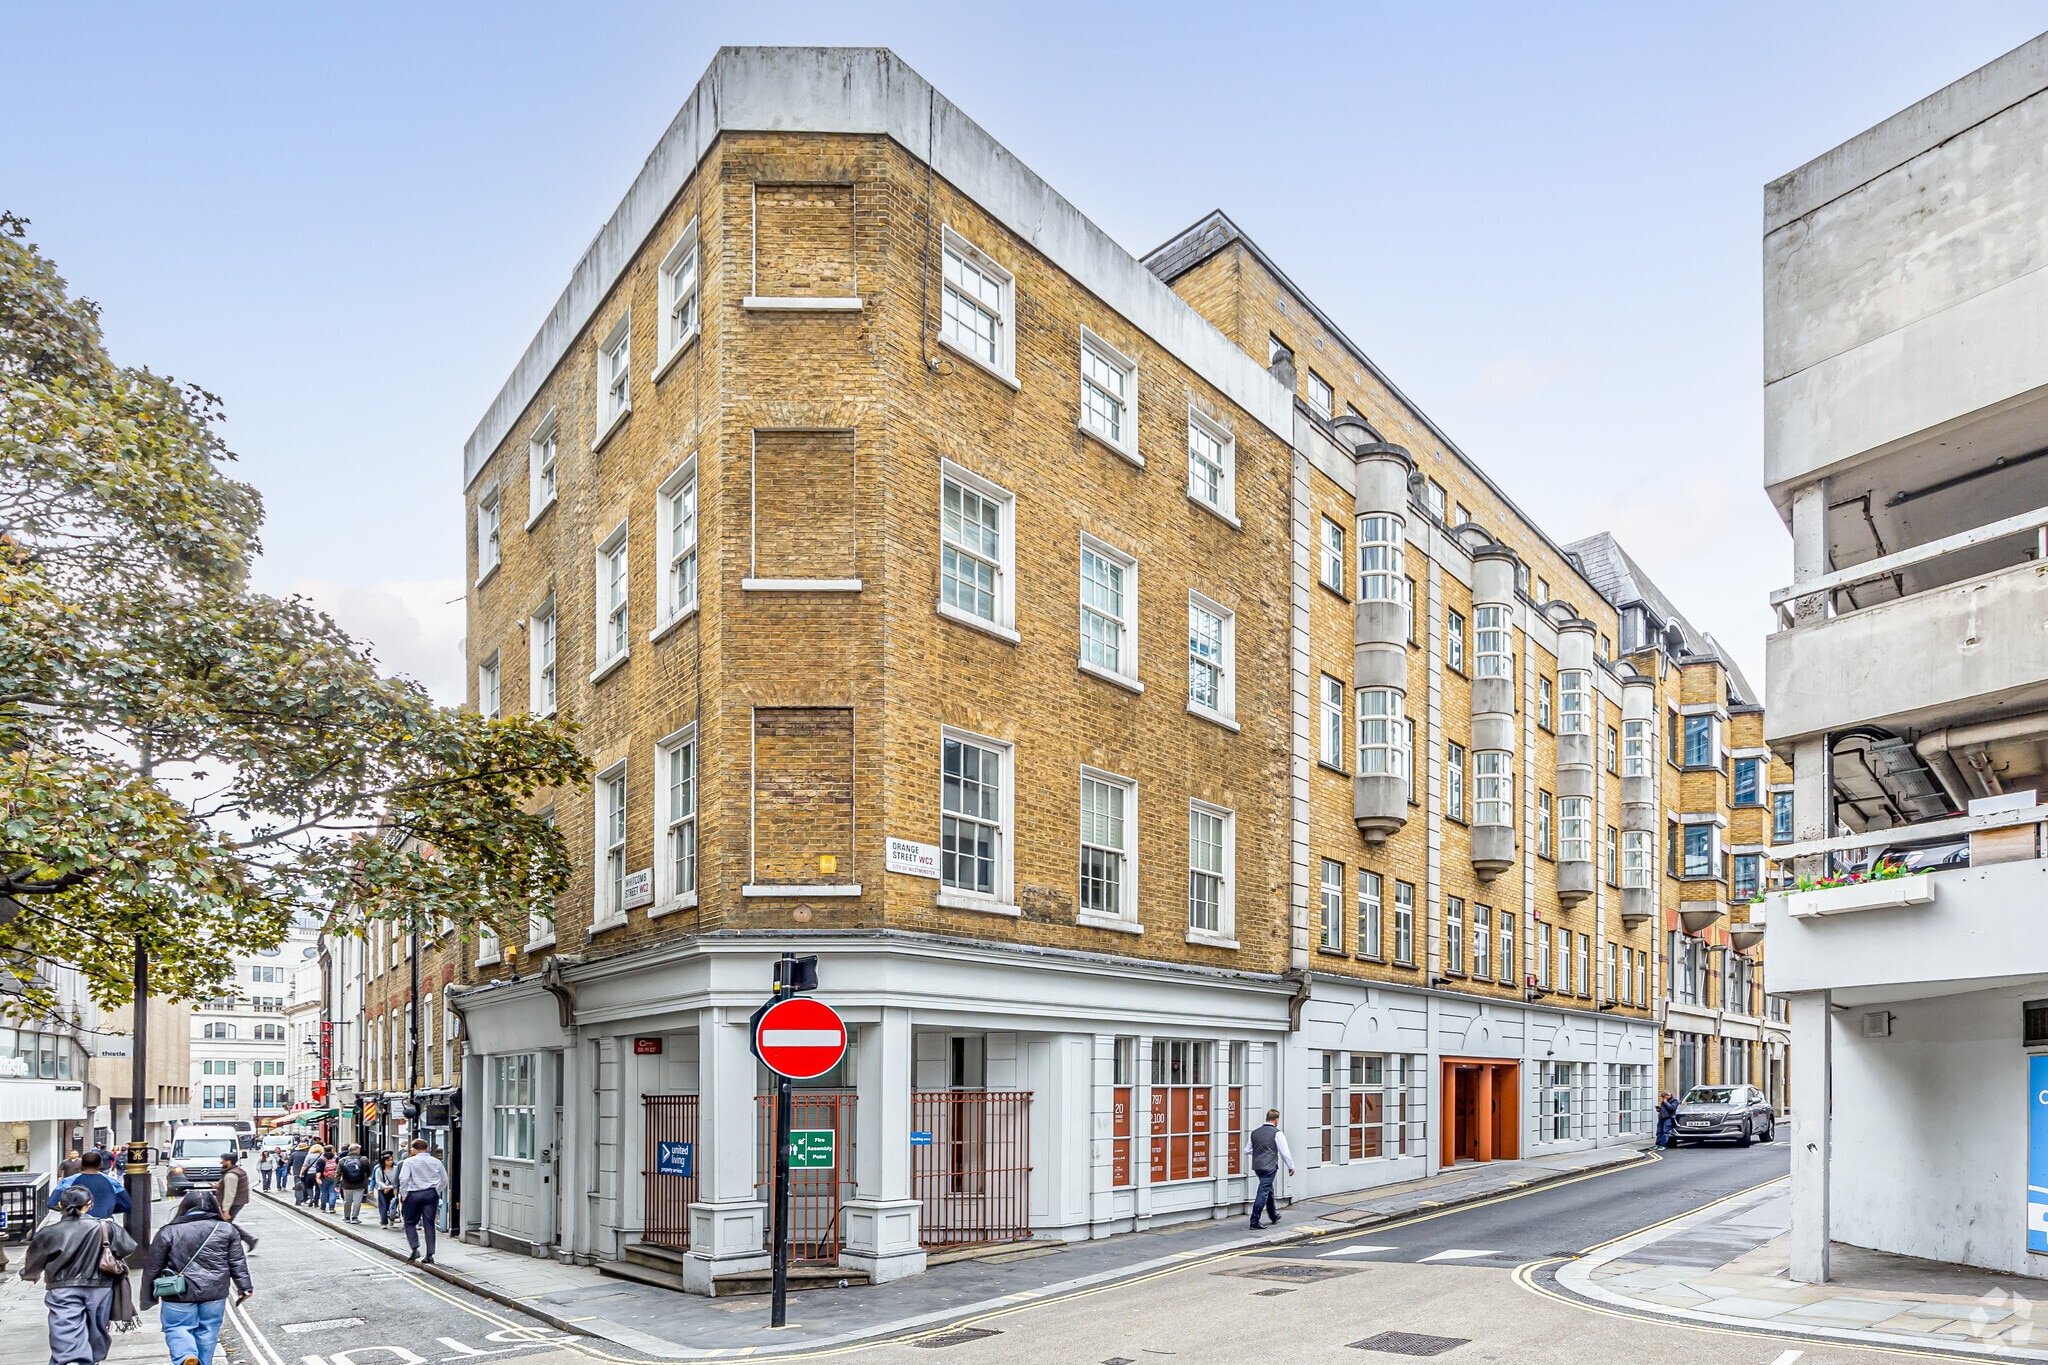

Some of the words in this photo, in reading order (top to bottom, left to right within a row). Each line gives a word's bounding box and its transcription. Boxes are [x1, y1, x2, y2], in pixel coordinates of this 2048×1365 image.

[892, 842, 919, 854] ORANGE
[892, 851, 917, 862] STREET
[919, 856, 933, 865] WC2
[908, 867, 936, 875] WESTMINSTER
[625, 872, 647, 887] WHITCOMB
[625, 886, 638, 898] STREET
[639, 883, 649, 893] WC2
[1151, 1095, 1162, 1104] 797
[1115, 1104, 1124, 1114] 20
[671, 1145, 689, 1155] united
[671, 1154, 685, 1168] living
